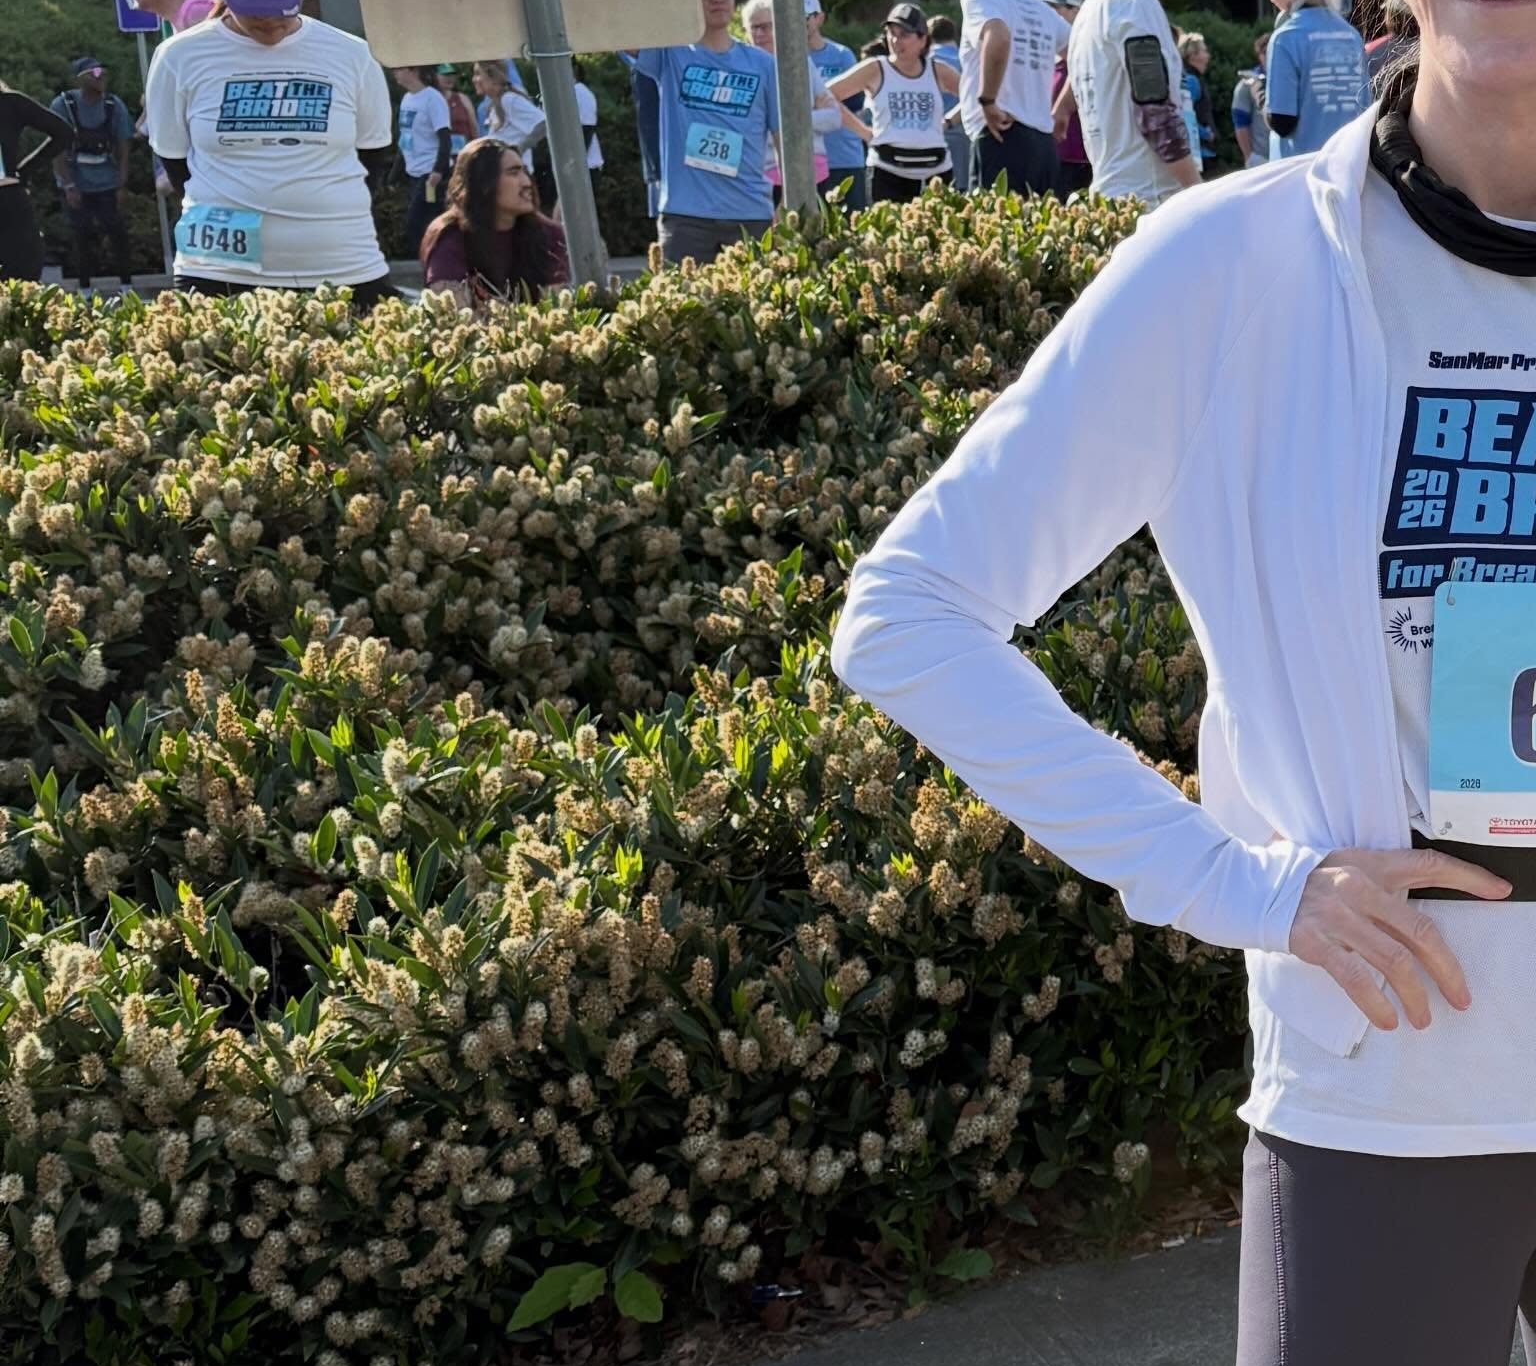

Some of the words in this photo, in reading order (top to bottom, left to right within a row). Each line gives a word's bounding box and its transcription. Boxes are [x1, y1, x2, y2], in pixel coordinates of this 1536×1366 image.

[226, 80, 289, 101] BEAT
[292, 81, 329, 98] THE
[698, 138, 731, 161] 238
[186, 222, 248, 255] 1648
[1428, 351, 1510, 371] SanMar
[1403, 469, 1450, 497] 20
[1399, 499, 1447, 529] 26
[1387, 559, 1445, 590] for
